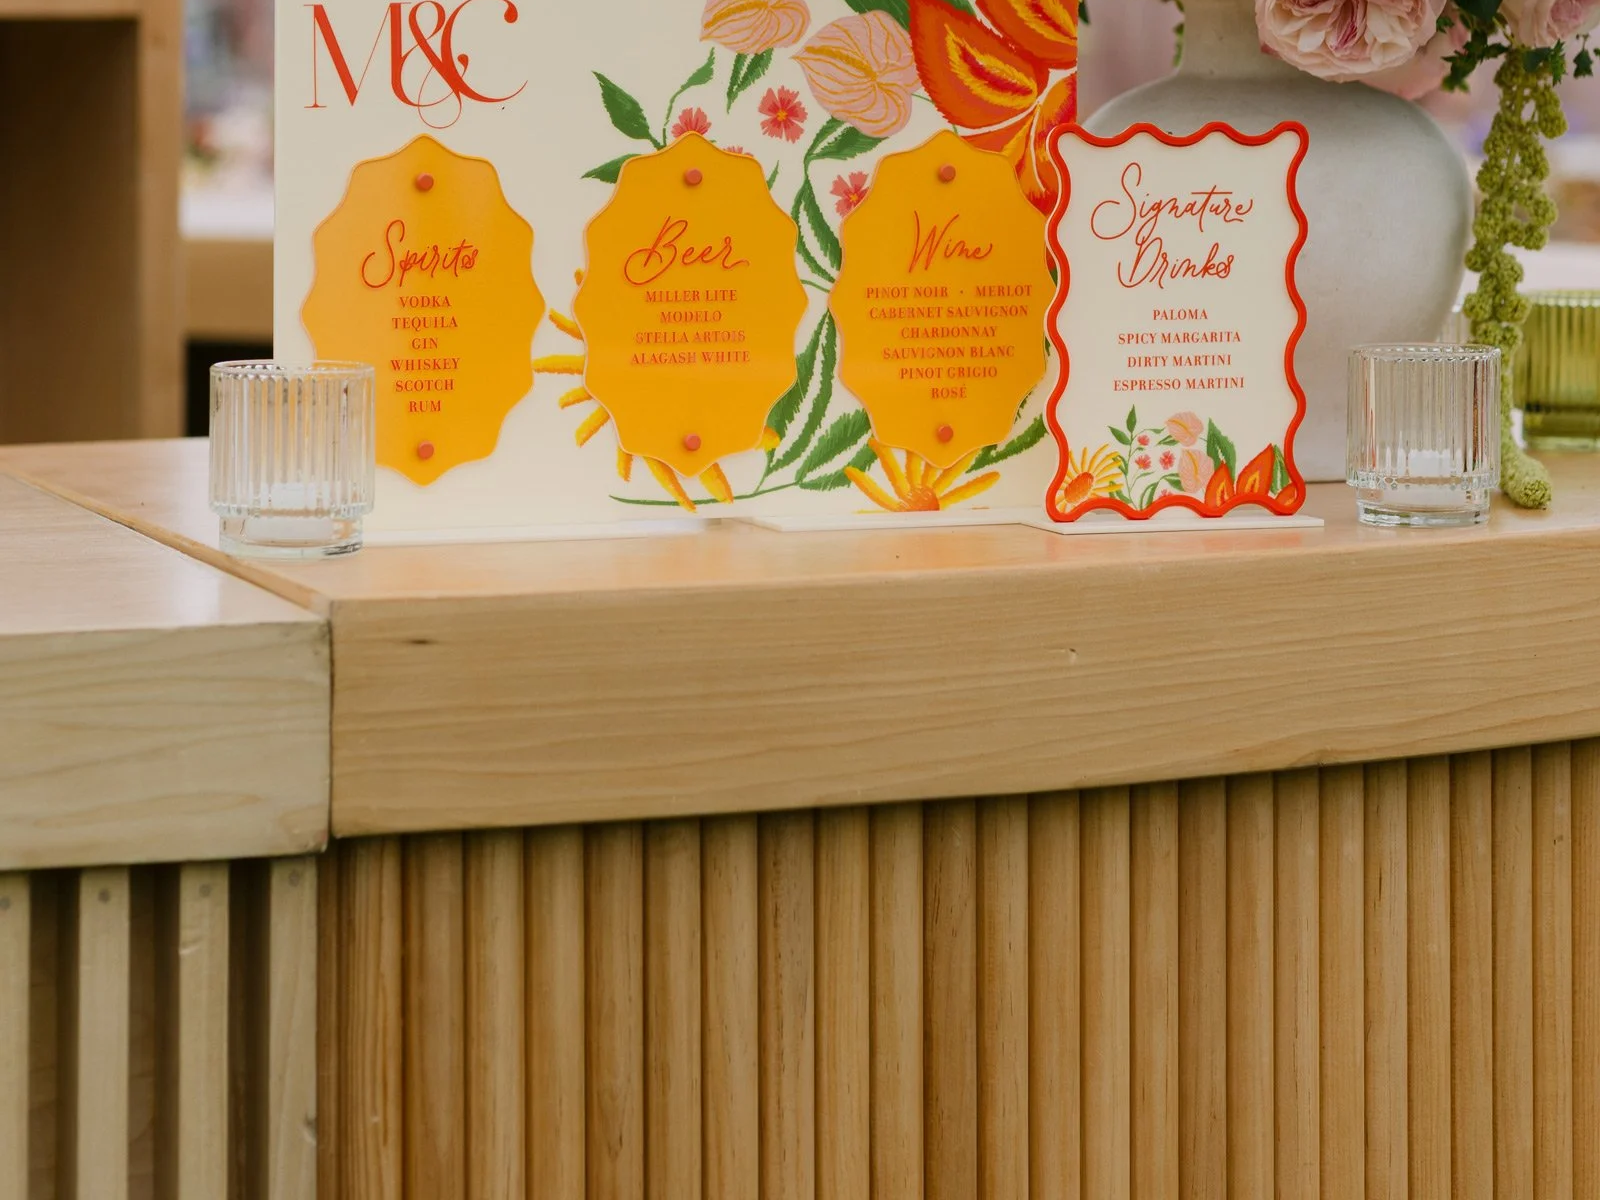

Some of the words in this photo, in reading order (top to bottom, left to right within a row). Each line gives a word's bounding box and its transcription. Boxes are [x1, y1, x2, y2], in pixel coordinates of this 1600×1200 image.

[1090, 162, 1253, 246] Signature
[908, 210, 993, 273] Wine
[361, 219, 479, 288] Spirits
[624, 215, 750, 286] Beer
[1117, 236, 1235, 289] Drinks
[645, 290, 700, 303] MILLER
[705, 289, 737, 301] LITE
[866, 286, 909, 299] PINOT
[914, 286, 949, 298] NOIR
[975, 284, 1033, 297] MERLOT
[399, 296, 451, 308] VODKA
[660, 310, 722, 323] MODELO
[869, 306, 943, 319] CABERNET
[947, 305, 1028, 318] SAUVIGNON
[1152, 309, 1208, 321] PALOMA
[391, 316, 458, 331] TEQUILA
[635, 331, 689, 344] STELLA
[693, 330, 745, 343] ARTOIS
[901, 326, 999, 339] CHARDONNAY
[1117, 333, 1157, 345] SPICY
[1161, 331, 1241, 344] MARGARITA
[411, 338, 438, 350] GIN
[630, 351, 696, 365] ALAGASH
[702, 350, 750, 363] WHITE
[883, 346, 965, 360] SAUVIGNON
[970, 345, 1015, 358] BLANC
[390, 357, 460, 371] WHISKEY
[1127, 355, 1169, 368] DIRTY
[1172, 354, 1232, 367] MARTINI
[900, 367, 943, 379] PINOT
[948, 366, 998, 379] GRIGIO
[395, 379, 454, 392] SCOTCH
[931, 383, 967, 399] ROSÉ
[1113, 378, 1181, 392] ESPRESSO
[1186, 376, 1245, 390] MARTINI
[408, 401, 442, 413] RUM
